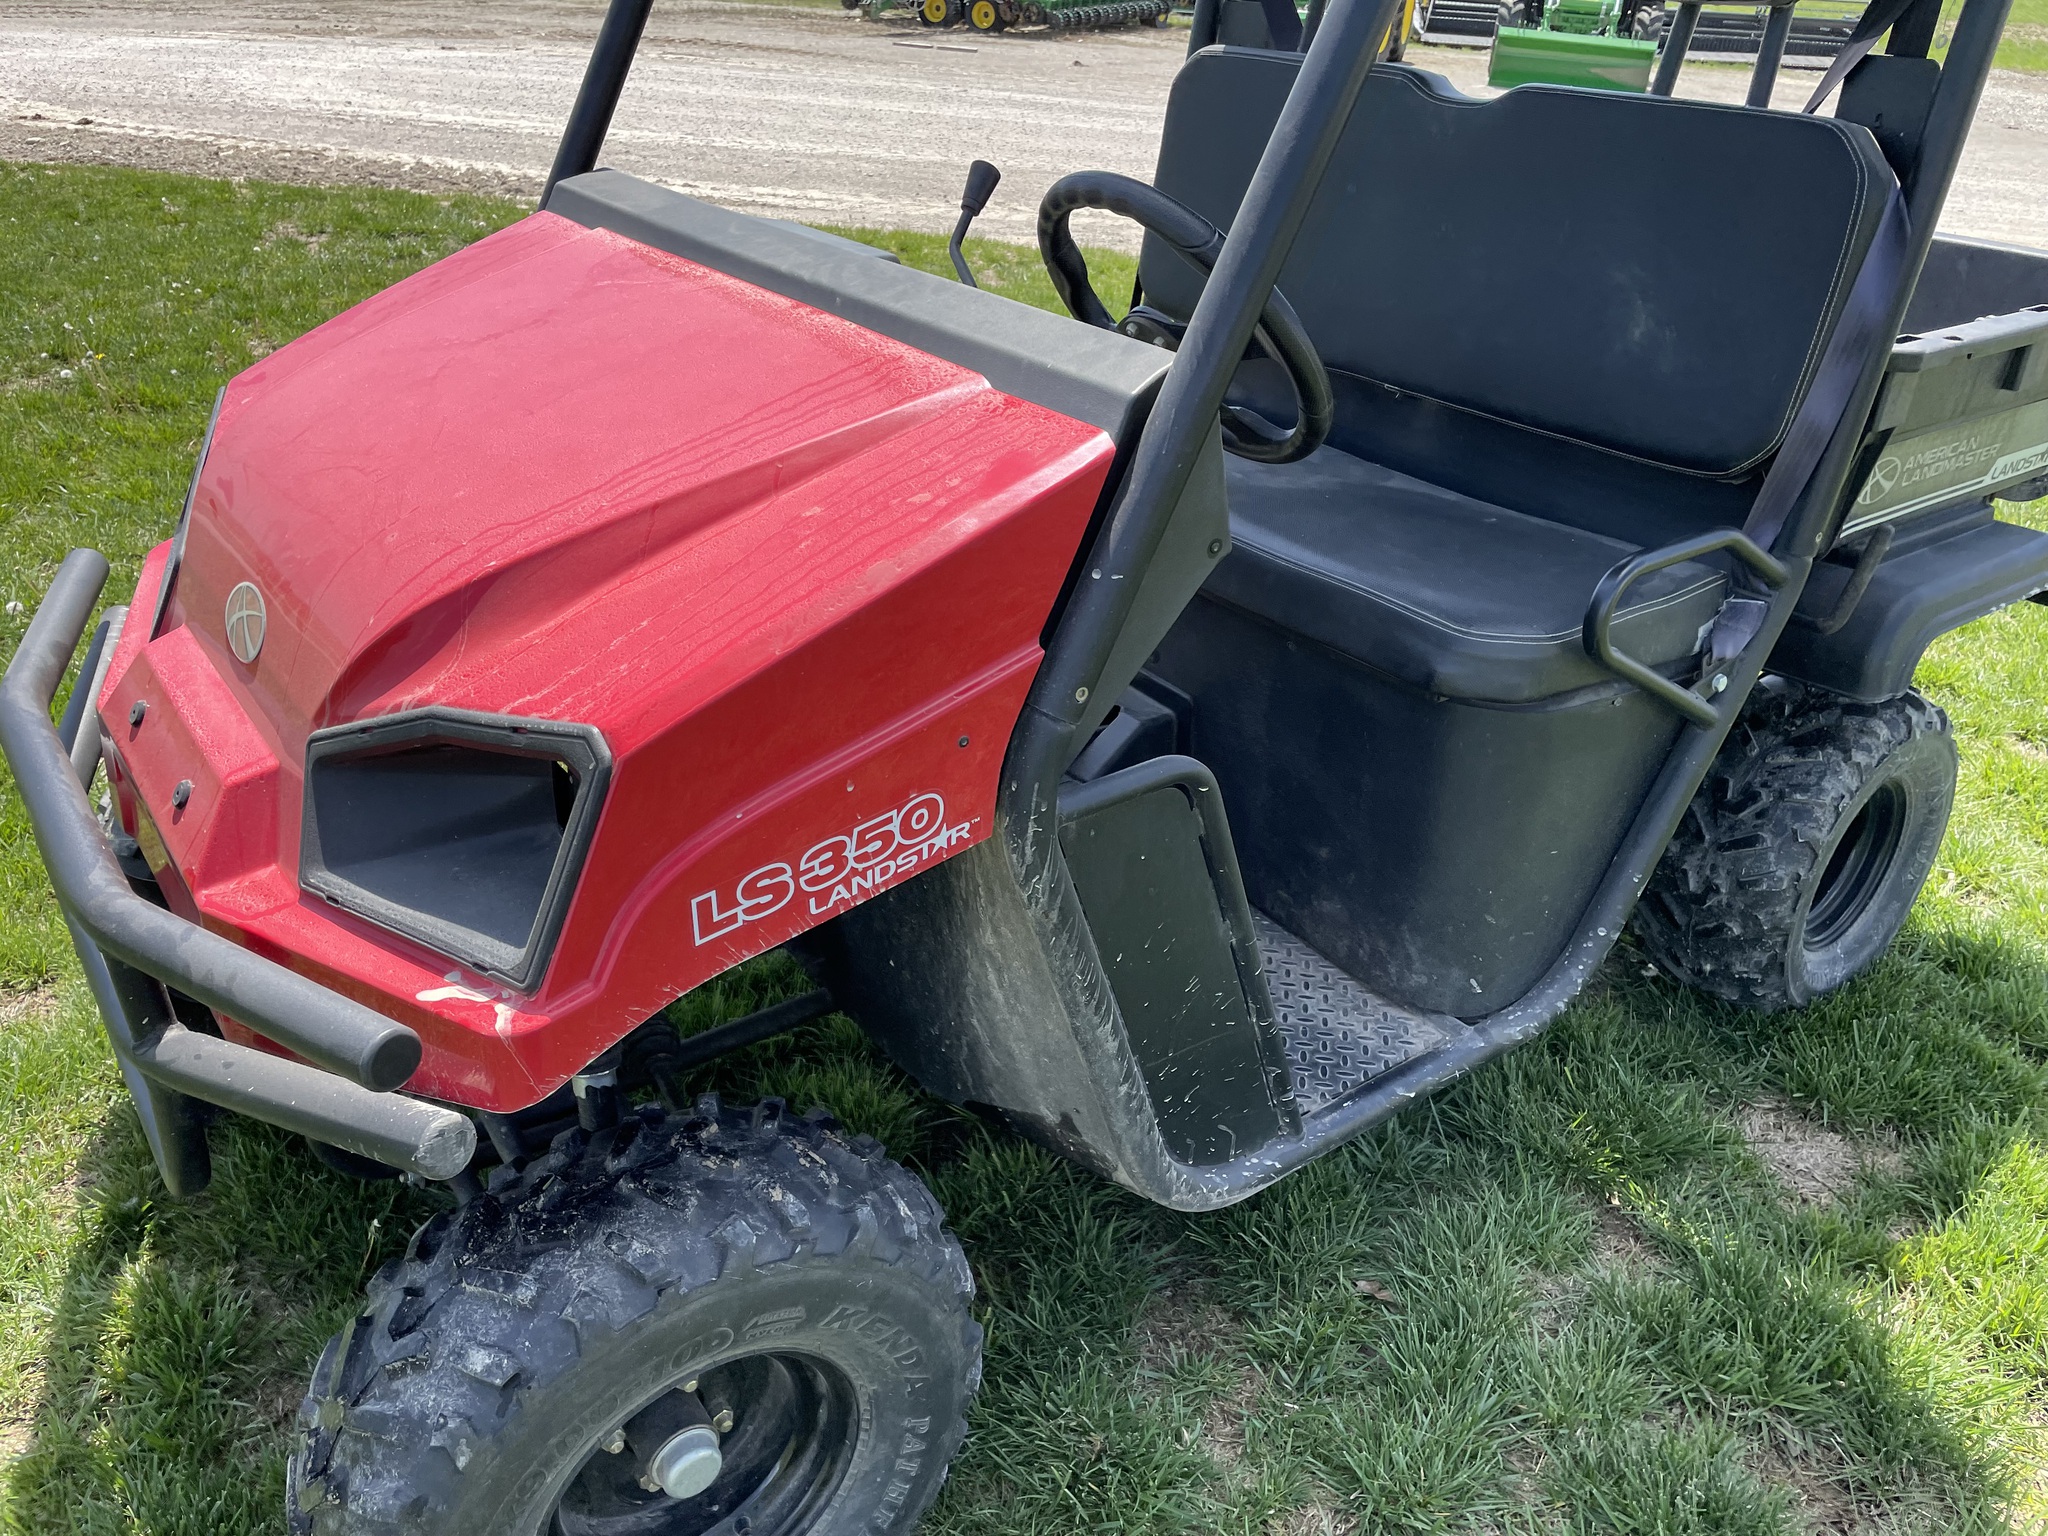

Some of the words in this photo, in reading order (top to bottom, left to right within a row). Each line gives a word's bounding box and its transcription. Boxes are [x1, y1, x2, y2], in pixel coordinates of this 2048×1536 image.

[1901, 443, 2001, 487] LANDMASTER
[1903, 436, 1979, 472] AMERICAN
[690, 862, 795, 947] LS
[799, 793, 944, 892] 350
[817, 1304, 931, 1400] KENDA
